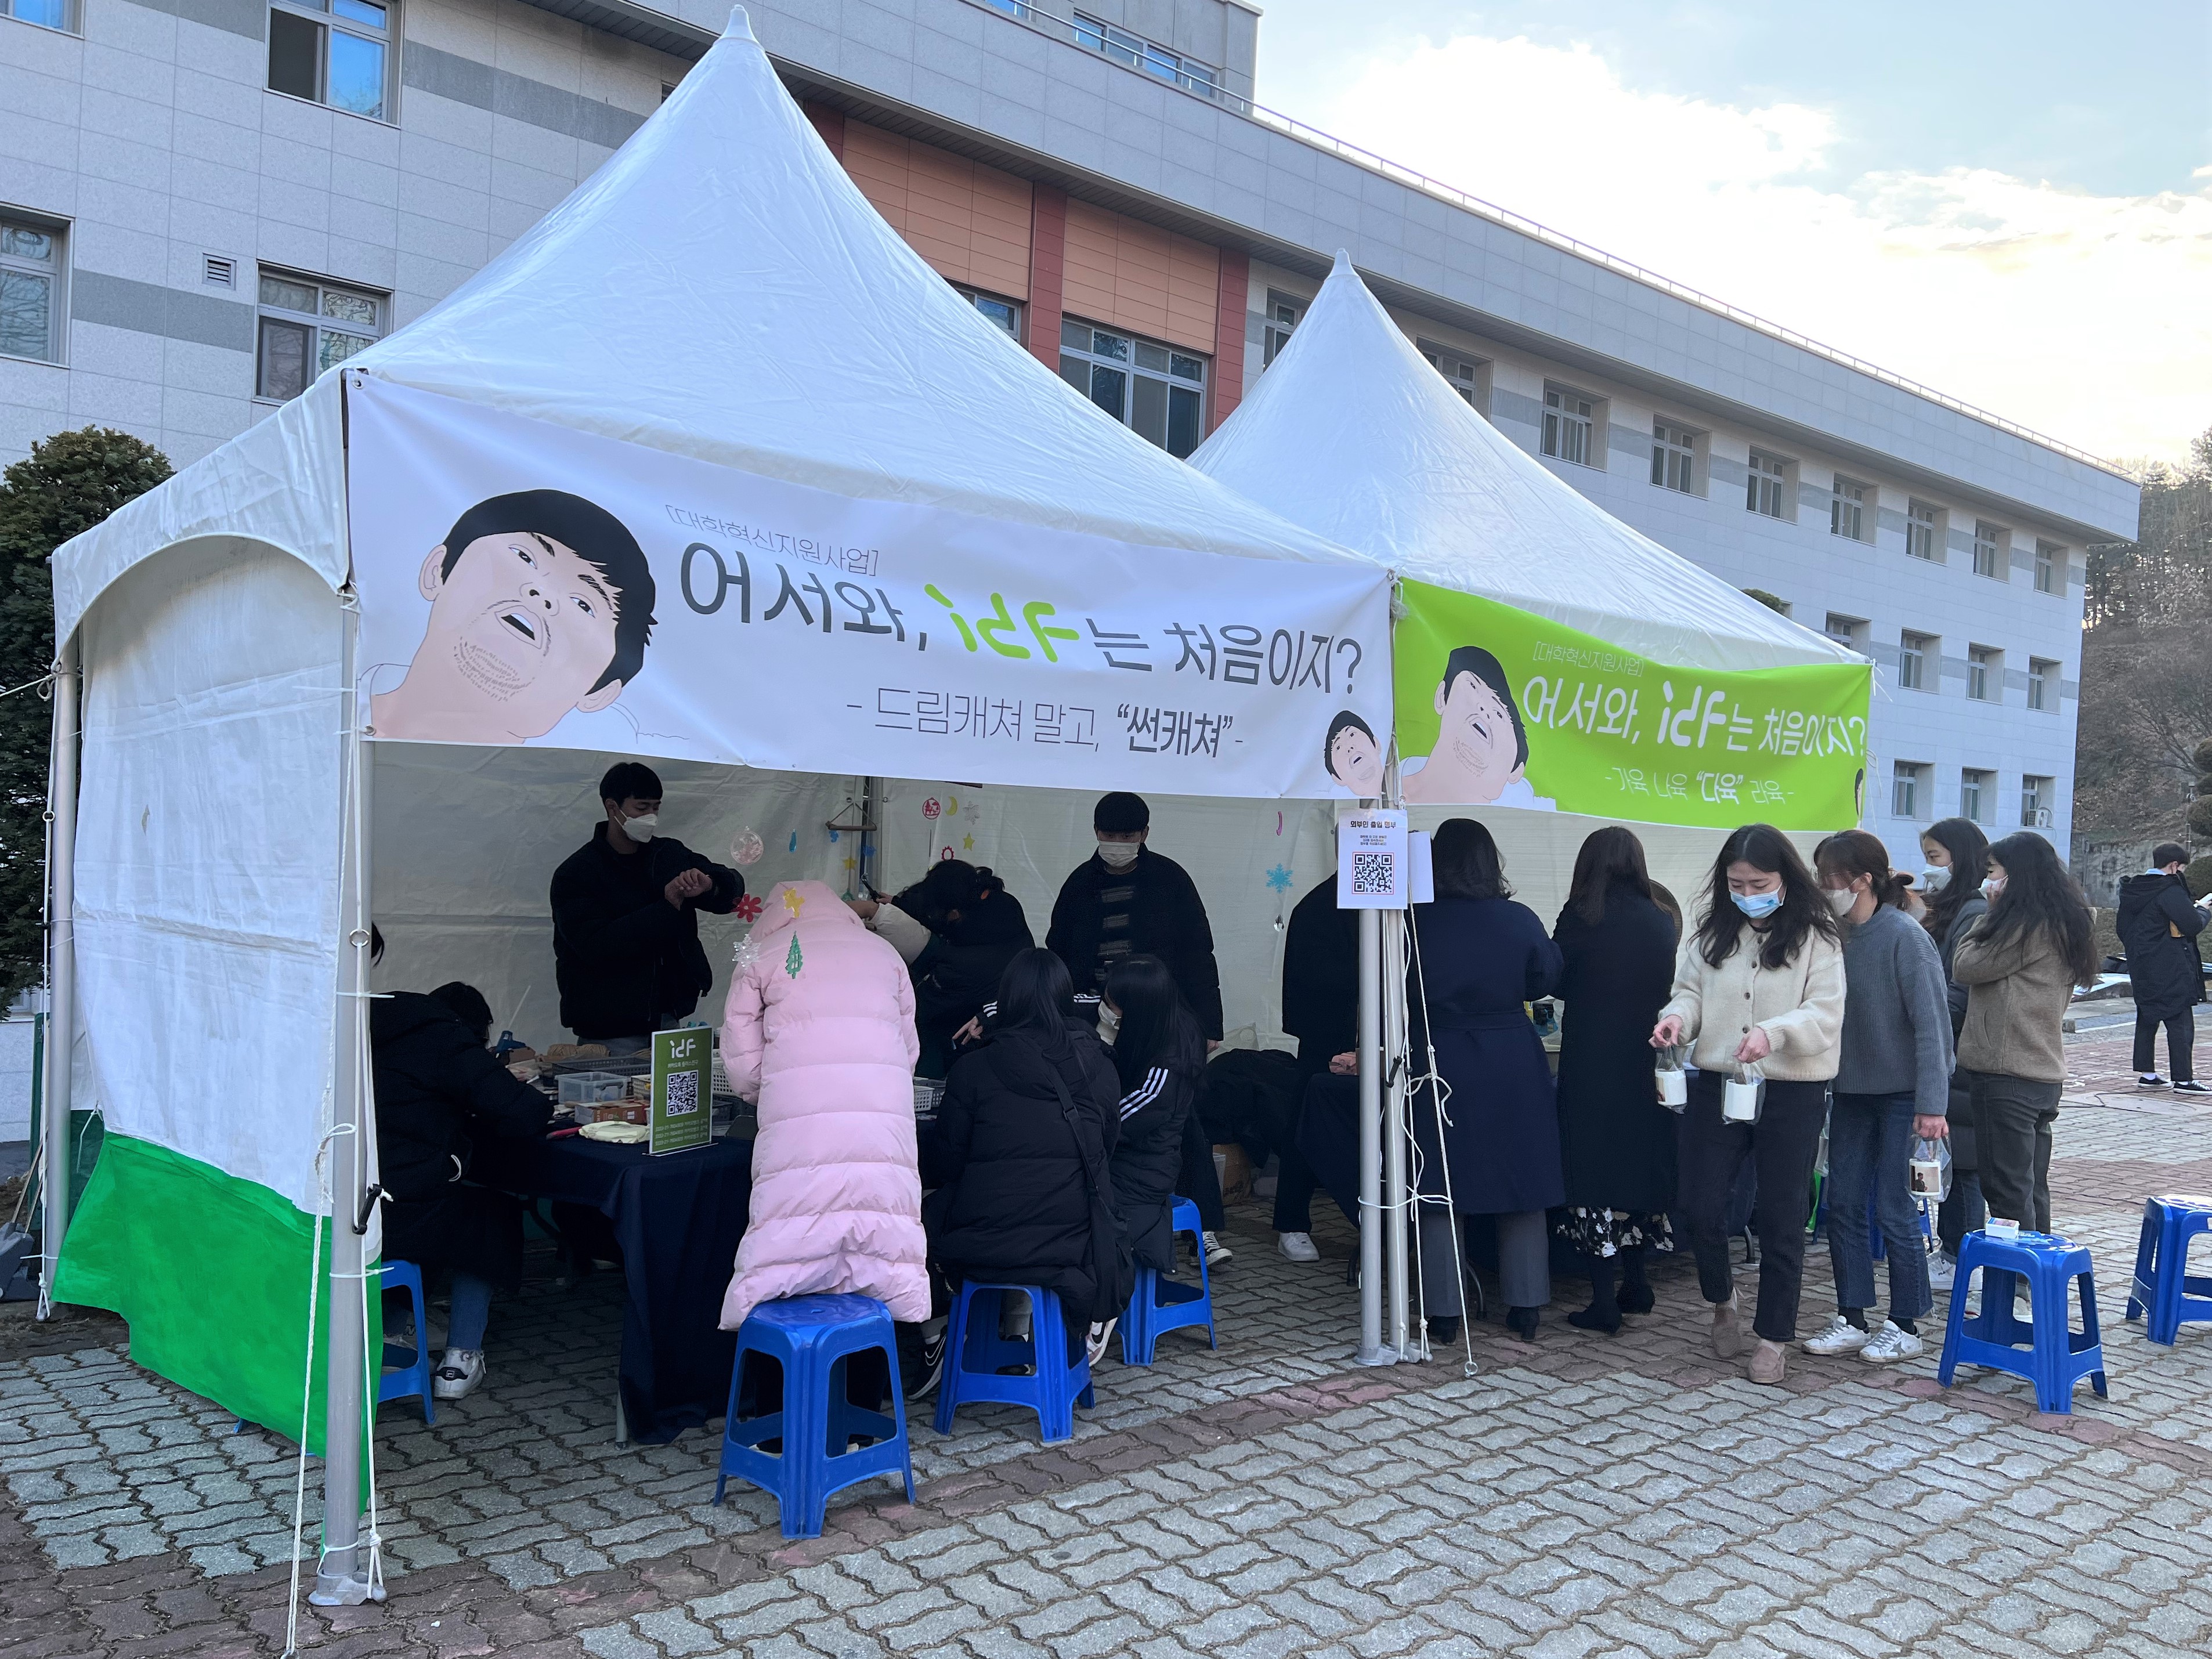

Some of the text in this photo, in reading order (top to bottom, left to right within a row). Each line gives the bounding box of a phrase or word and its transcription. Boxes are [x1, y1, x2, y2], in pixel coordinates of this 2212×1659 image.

[666, 504, 879, 576] [대학혁신지원사업]
[681, 542, 927, 651] 어서와,
[1163, 622, 1362, 693] 처음이지?
[1533, 641, 1644, 677] [대학혁신지원사업]
[875, 688, 1021, 742] 드림캐쳐
[1035, 703, 1099, 753] 말고,
[1523, 676, 1640, 744] 어서와,
[1758, 707, 1866, 757] 처음이지?
[1653, 772, 1689, 801] 나육
[1384, 821, 1397, 829] 명부
